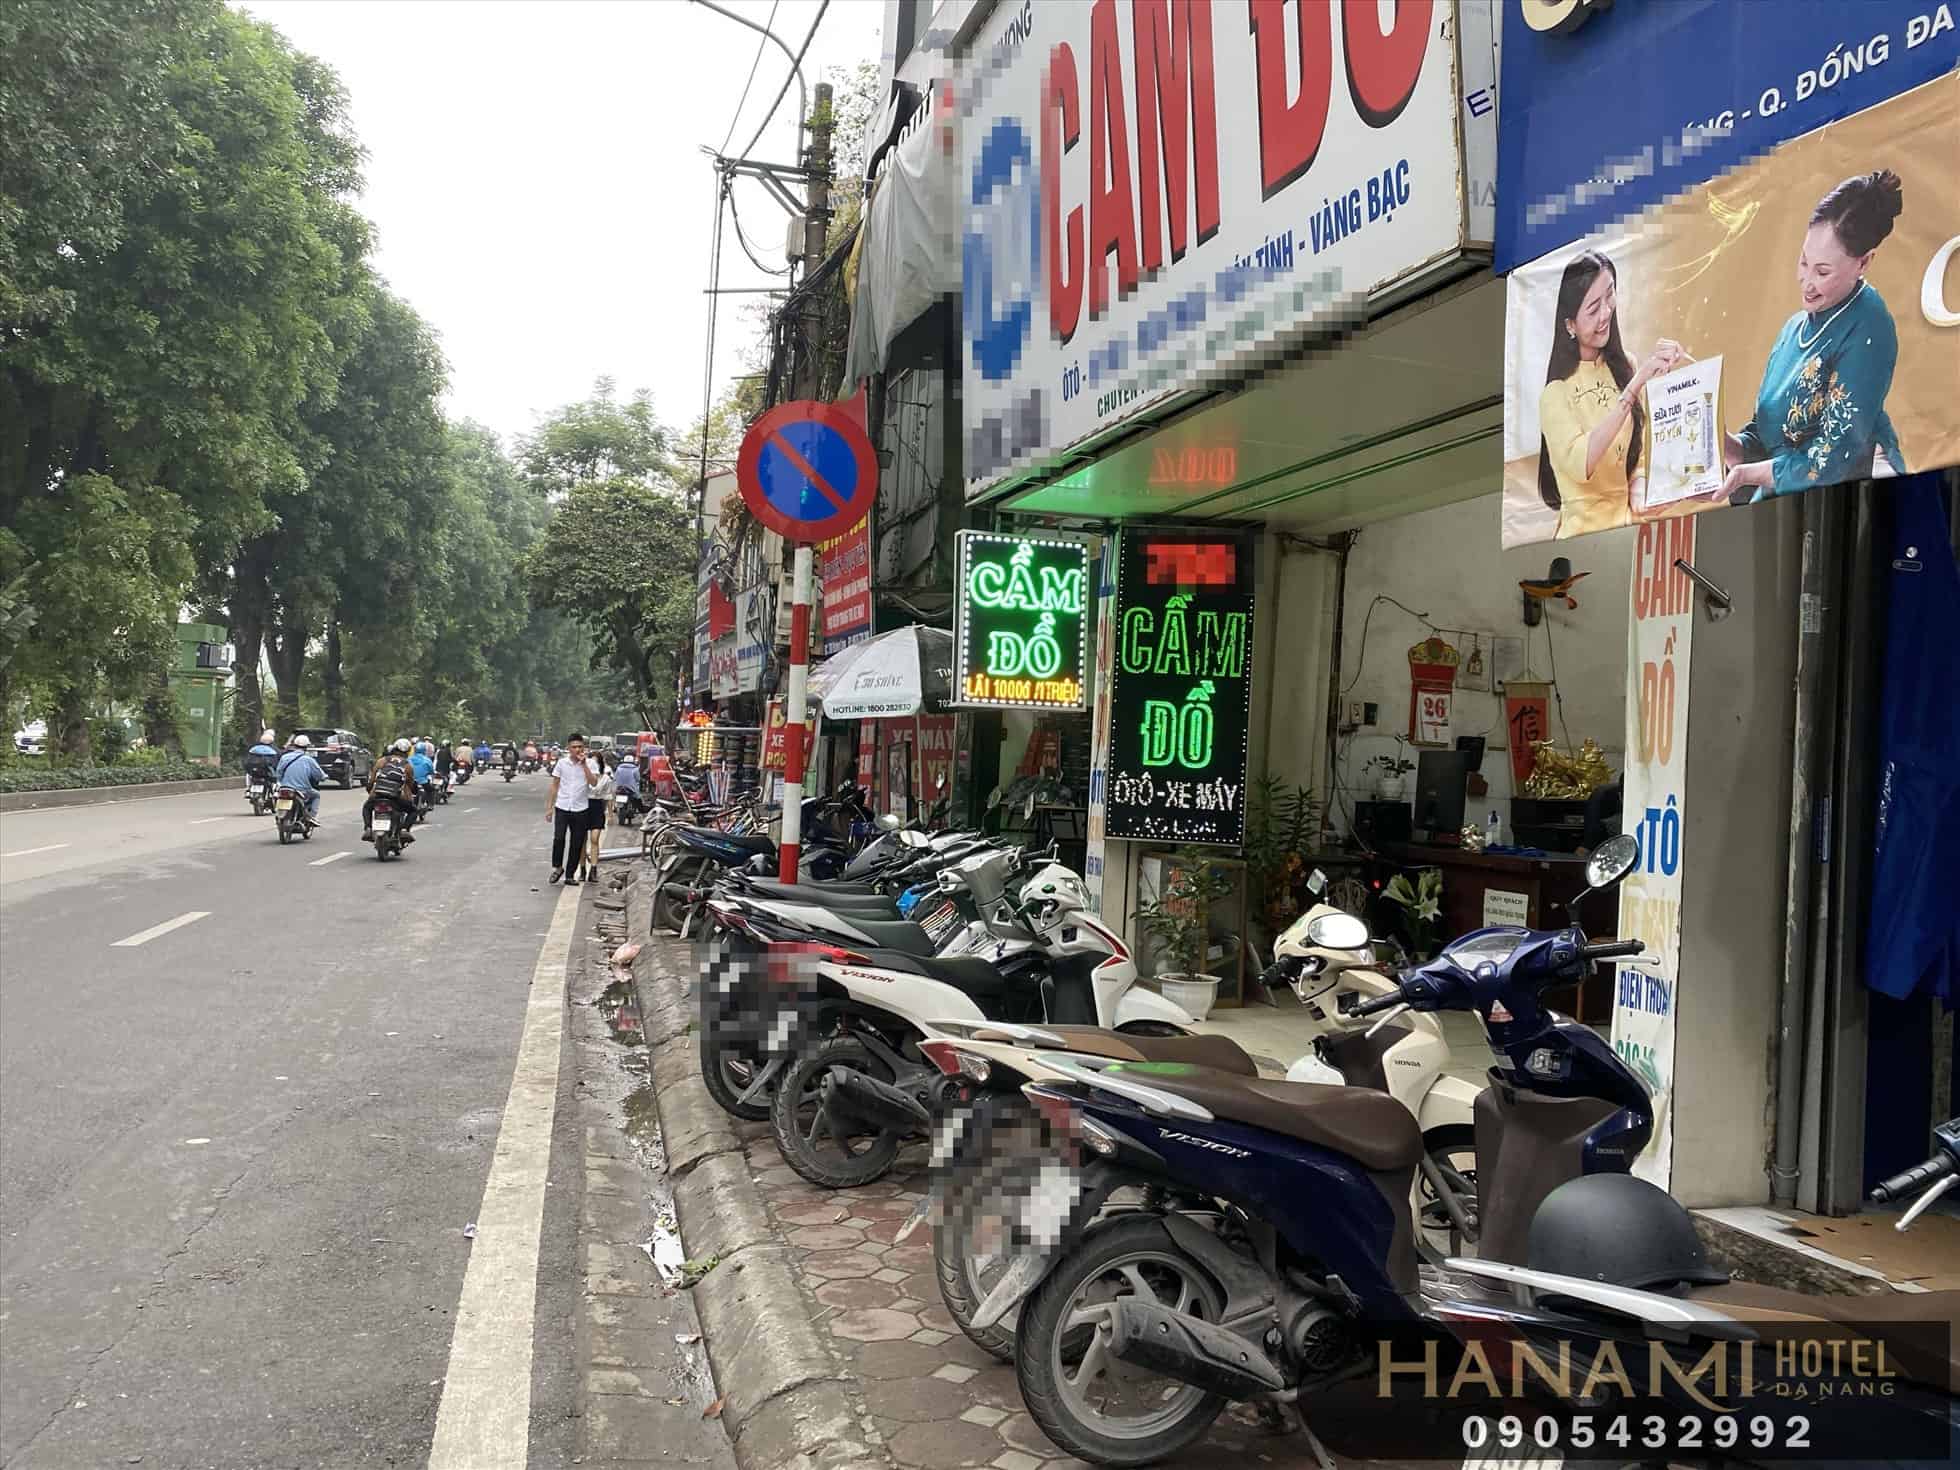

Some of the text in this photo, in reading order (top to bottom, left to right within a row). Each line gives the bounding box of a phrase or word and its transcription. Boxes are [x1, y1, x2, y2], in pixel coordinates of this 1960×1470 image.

[1759, 88, 1787, 117] Q.
[1796, 34, 1889, 101] ĐỐNG
[1906, 4, 1955, 48] ĐA
[1310, 198, 1361, 255] VÀNG
[1367, 159, 1410, 223] BẠC
[1667, 378, 1697, 395] VINAMILK
[970, 543, 1082, 613] CẦM
[987, 612, 1062, 678] ĐỒ
[1423, 697, 1447, 718] 26
[840, 969, 896, 983] VISION
[1157, 1128, 1252, 1159] VISION
